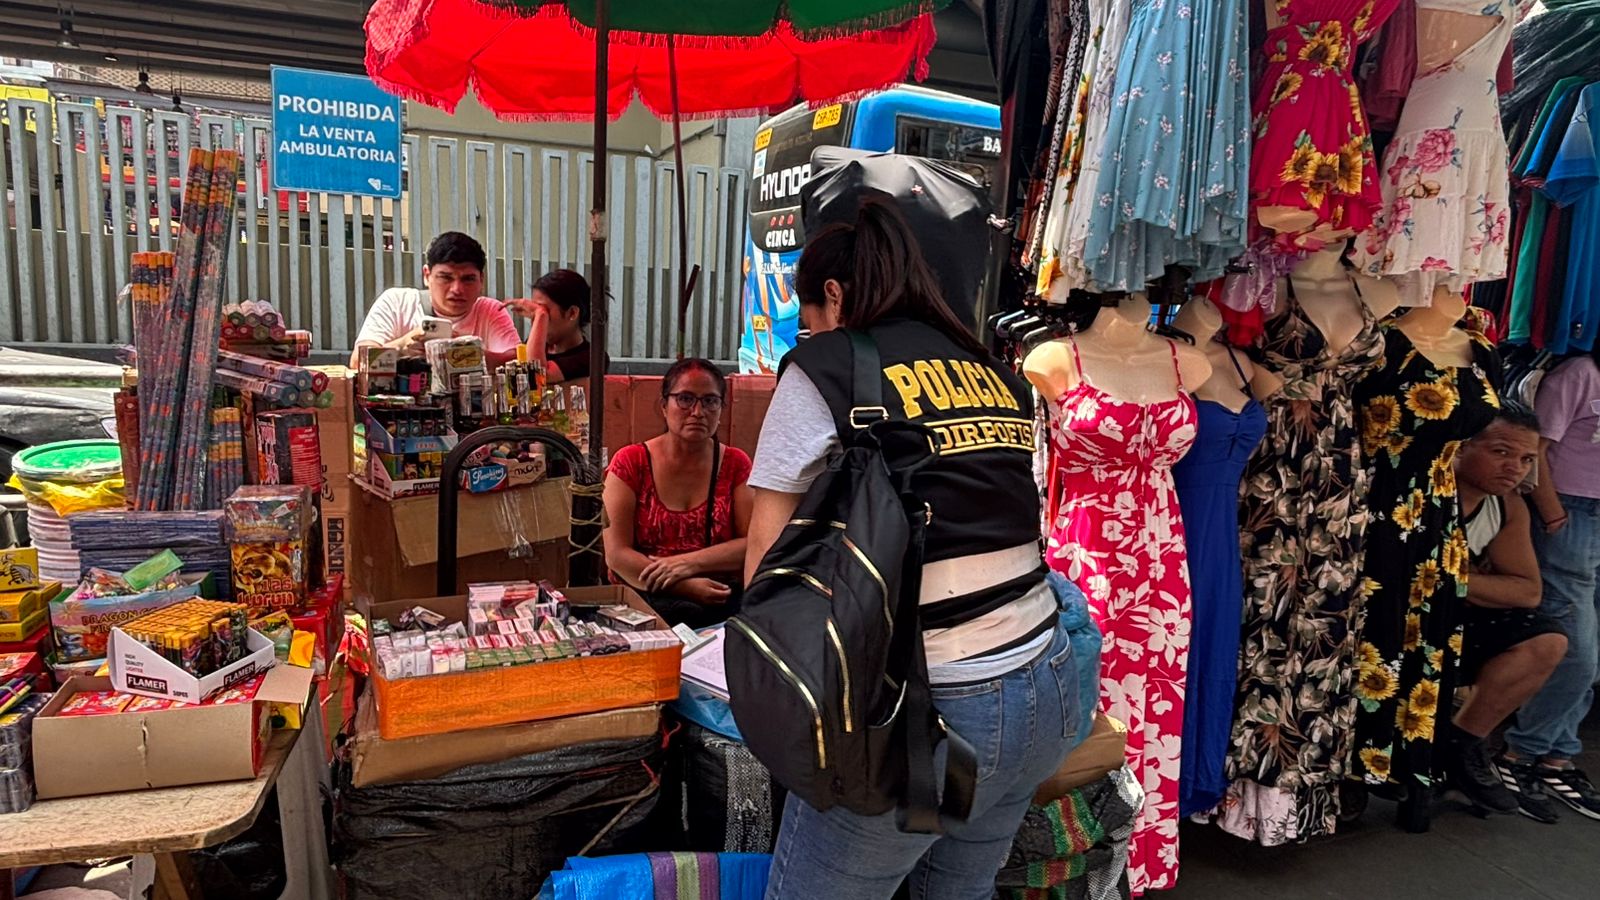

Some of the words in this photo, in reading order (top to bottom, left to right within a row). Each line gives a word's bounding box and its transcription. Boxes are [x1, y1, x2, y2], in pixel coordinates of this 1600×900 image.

[279, 94, 396, 122] PROHIBIDA
[299, 123, 320, 138] LA
[323, 126, 376, 144] VENTA
[279, 140, 396, 164] AMBULATORIA
[765, 228, 796, 248] CINCA
[883, 359, 1020, 420] POLICIA
[472, 467, 504, 485] Smoking
[81, 609, 138, 626] DRAGON
[125, 659, 144, 667] QUALITY
[127, 676, 166, 691] FLAMER
[225, 664, 255, 686] FLAMER
